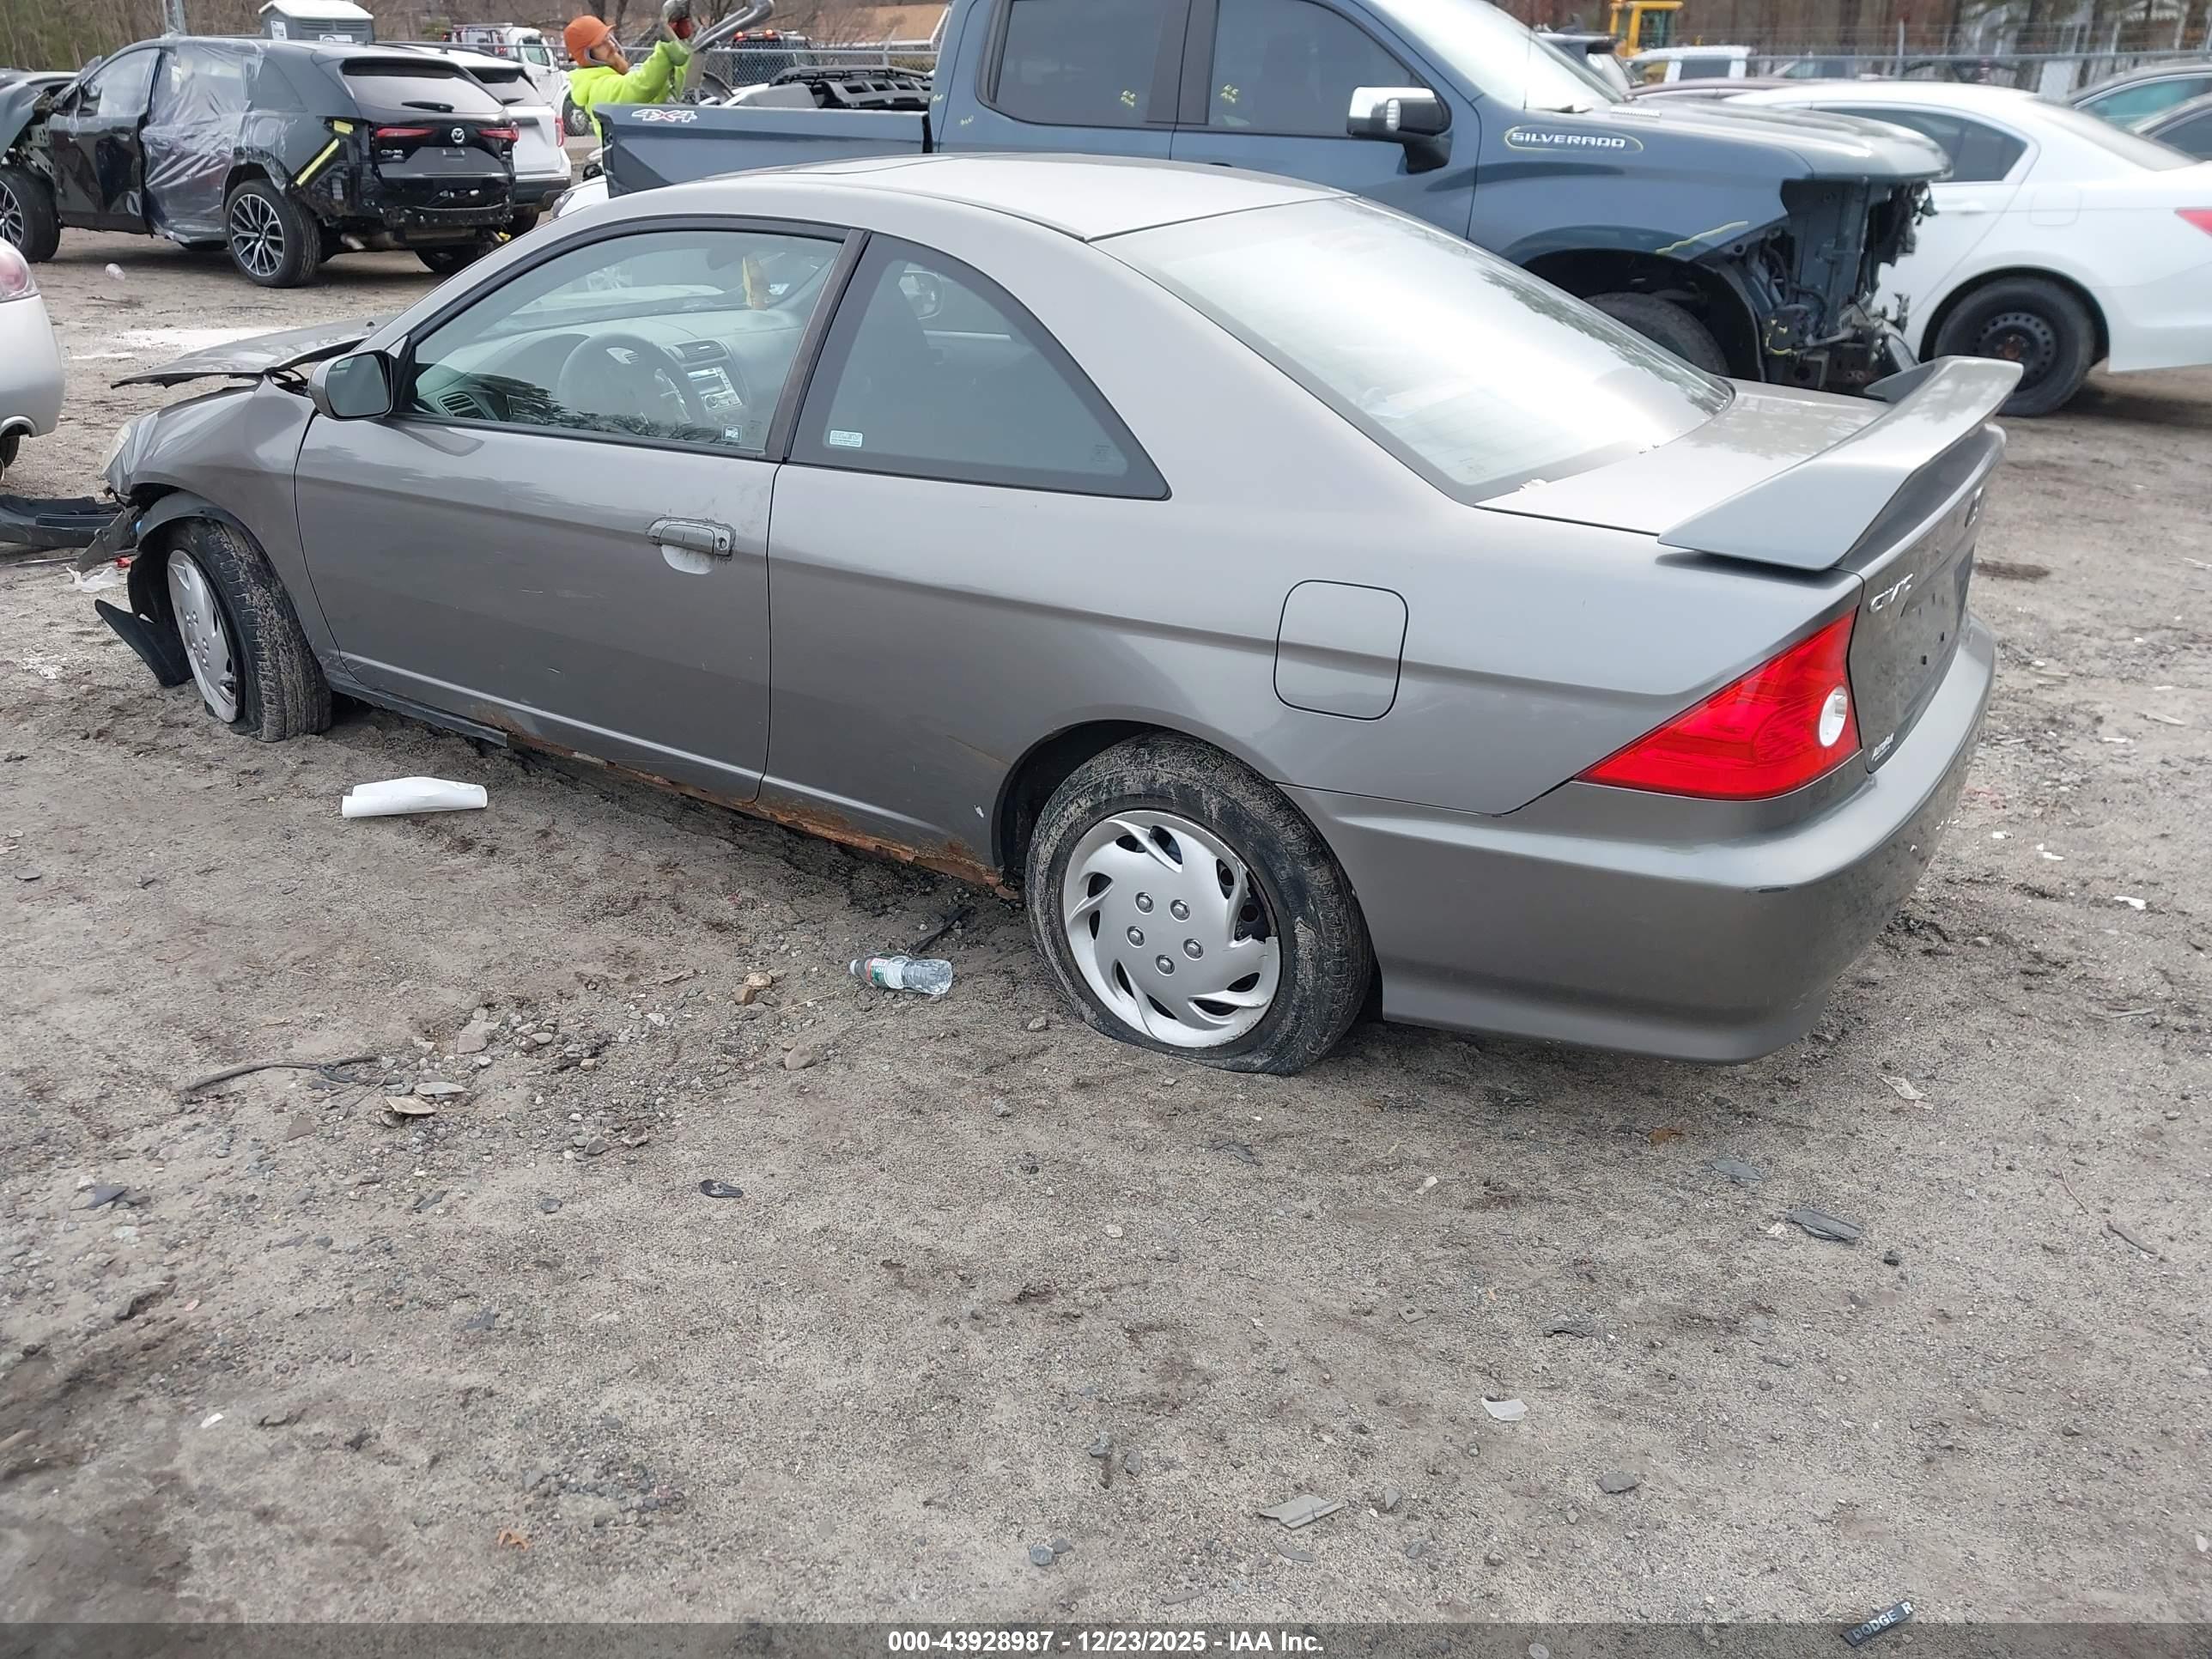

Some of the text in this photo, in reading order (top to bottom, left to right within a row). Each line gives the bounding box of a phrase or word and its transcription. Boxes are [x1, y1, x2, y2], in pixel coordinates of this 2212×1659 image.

[1510, 131, 1626, 149] SILVERADO
[1851, 1601, 1914, 1640] DODGE R
